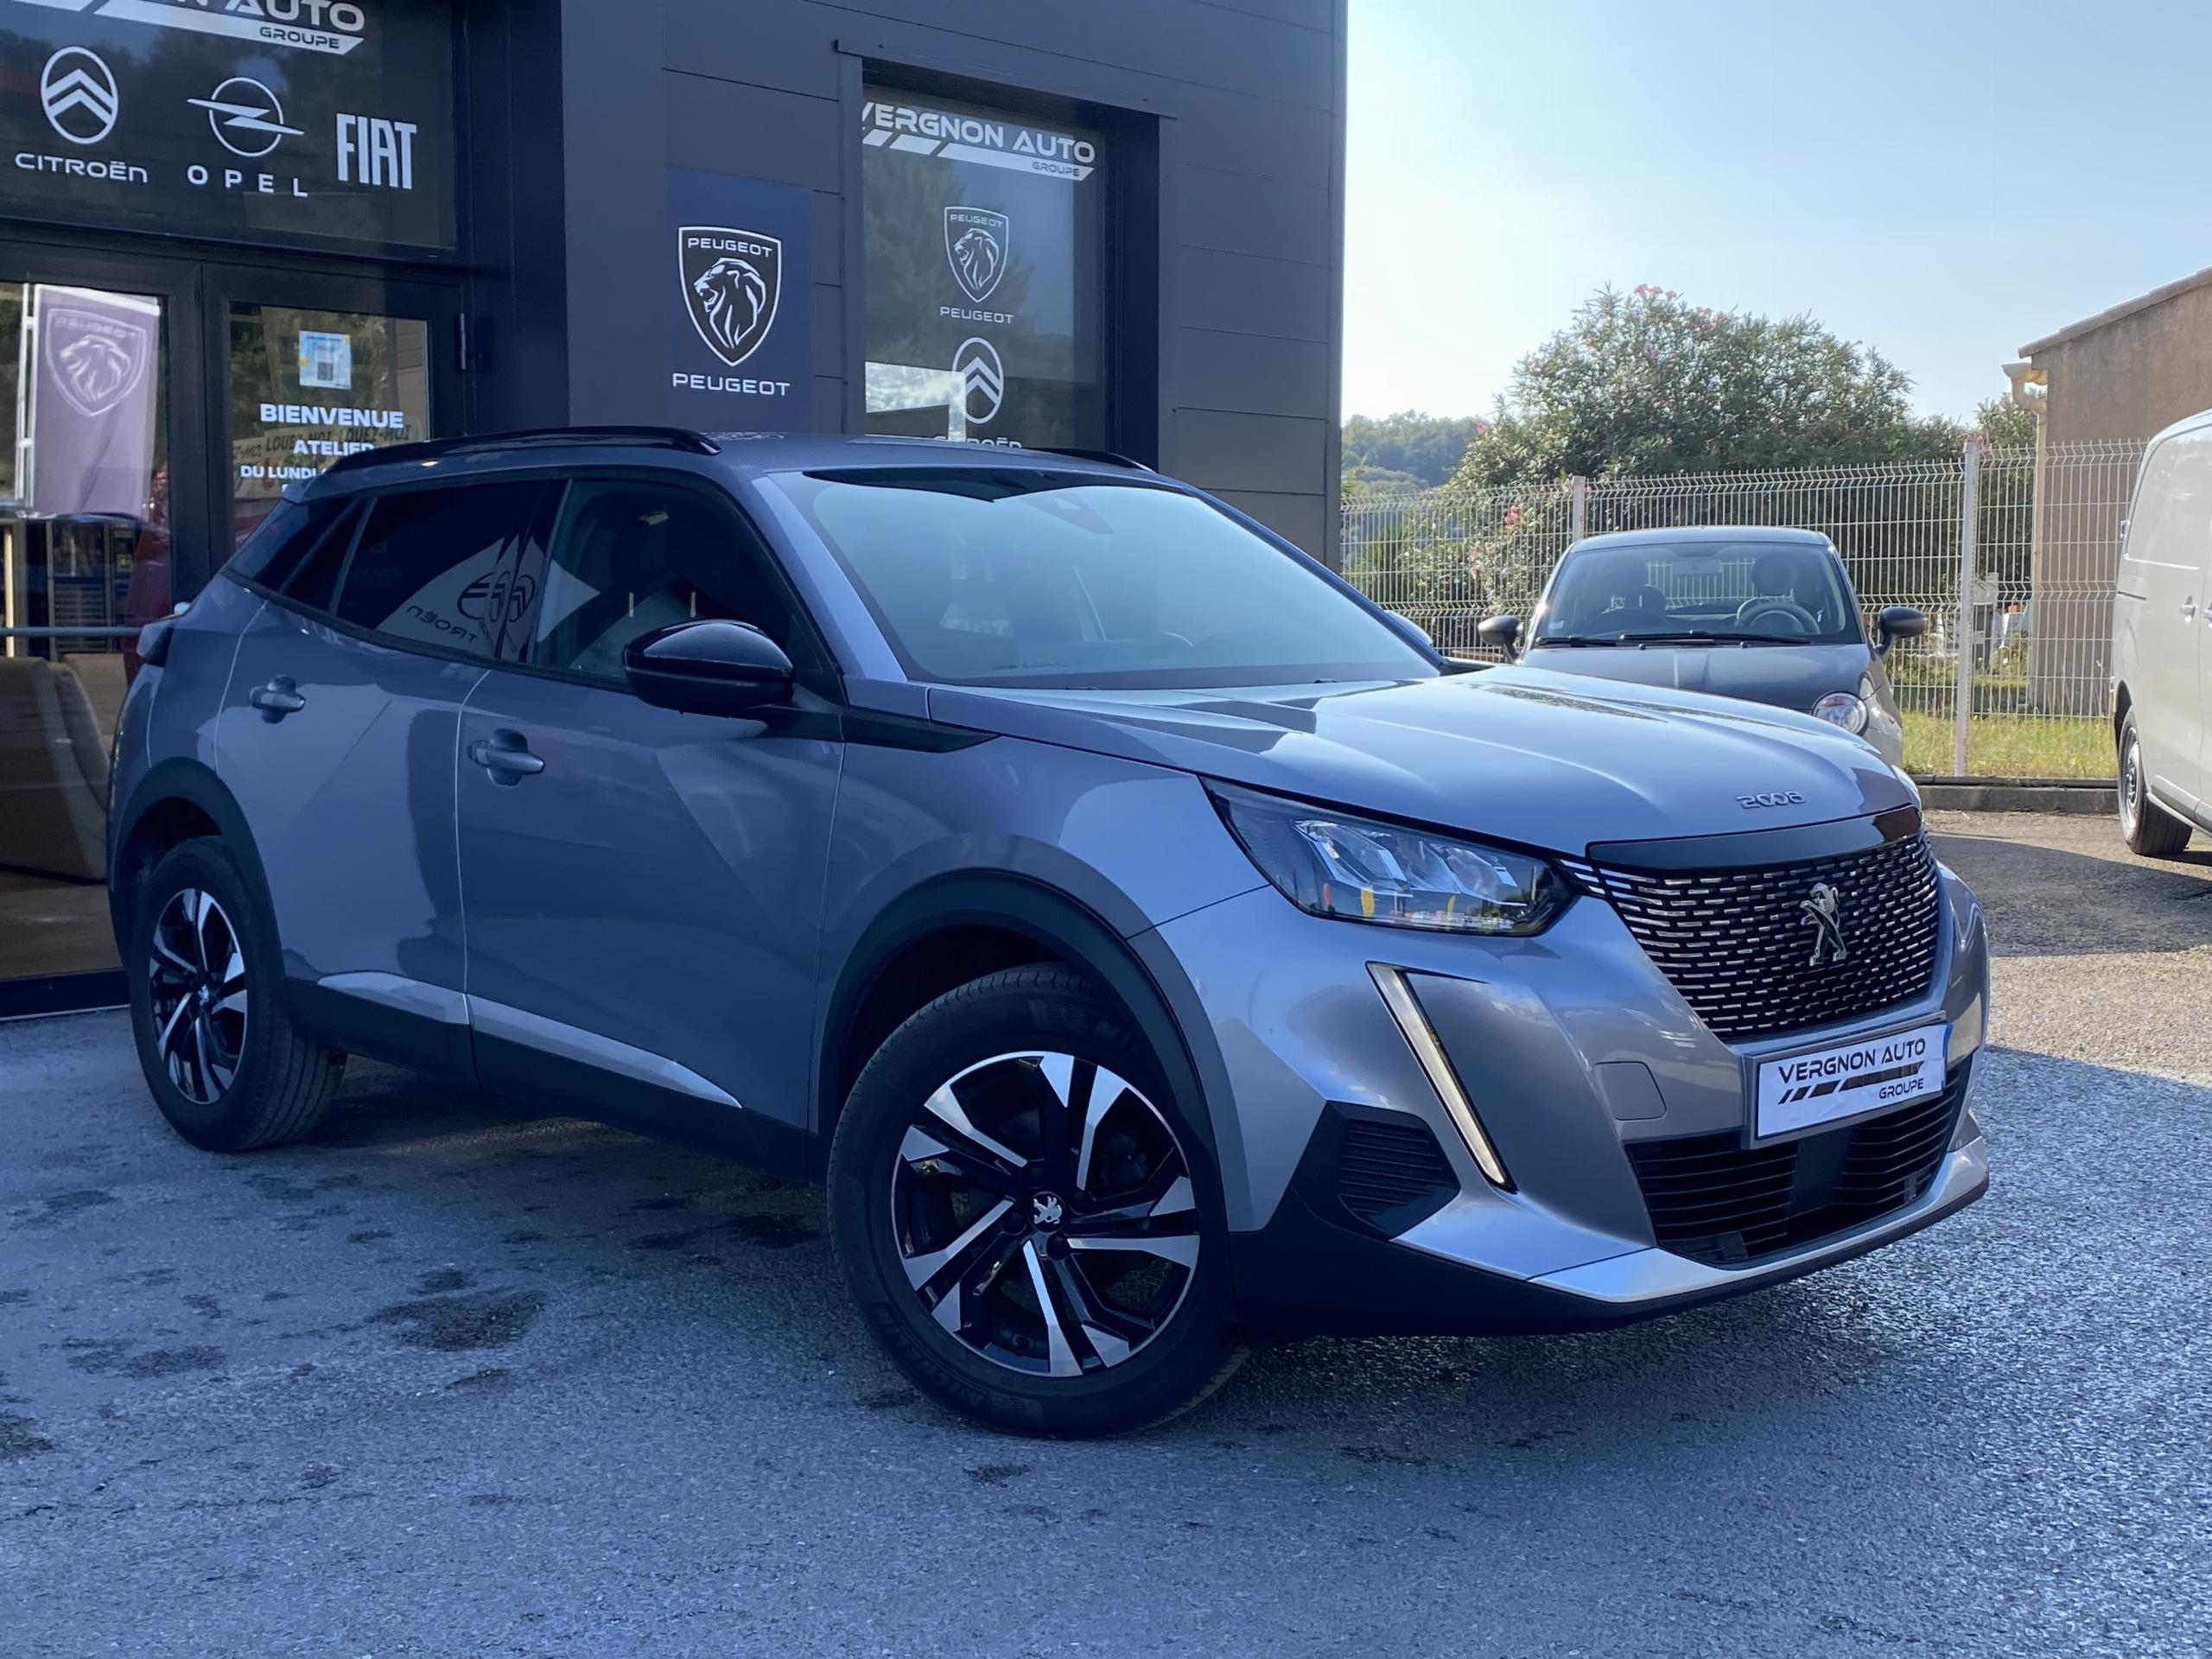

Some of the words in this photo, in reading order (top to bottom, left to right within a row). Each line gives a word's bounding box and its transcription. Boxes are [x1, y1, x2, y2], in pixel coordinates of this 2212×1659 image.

[260, 26, 340, 49] GROUPE
[336, 112, 416, 189] FIAT
[1012, 130, 1096, 162] AUTO
[15, 153, 147, 183] CITROËN
[1033, 162, 1080, 176] GROUPE
[188, 165, 308, 197] OPEL
[950, 213, 1003, 228] PEUGEOT
[688, 238, 772, 257] PEUGEOT
[940, 306, 1014, 324] PEUGEOT
[672, 372, 791, 397] PEUGEOT
[260, 404, 404, 429] BIENVENUE
[241, 466, 264, 478] DU
[268, 466, 317, 480] LUNDI
[1736, 791, 1805, 809] 2008
[1778, 1049, 1876, 1084] VERGNON
[1881, 1038, 1925, 1065] AUTO
[1878, 1078, 1924, 1099] GROUPE
